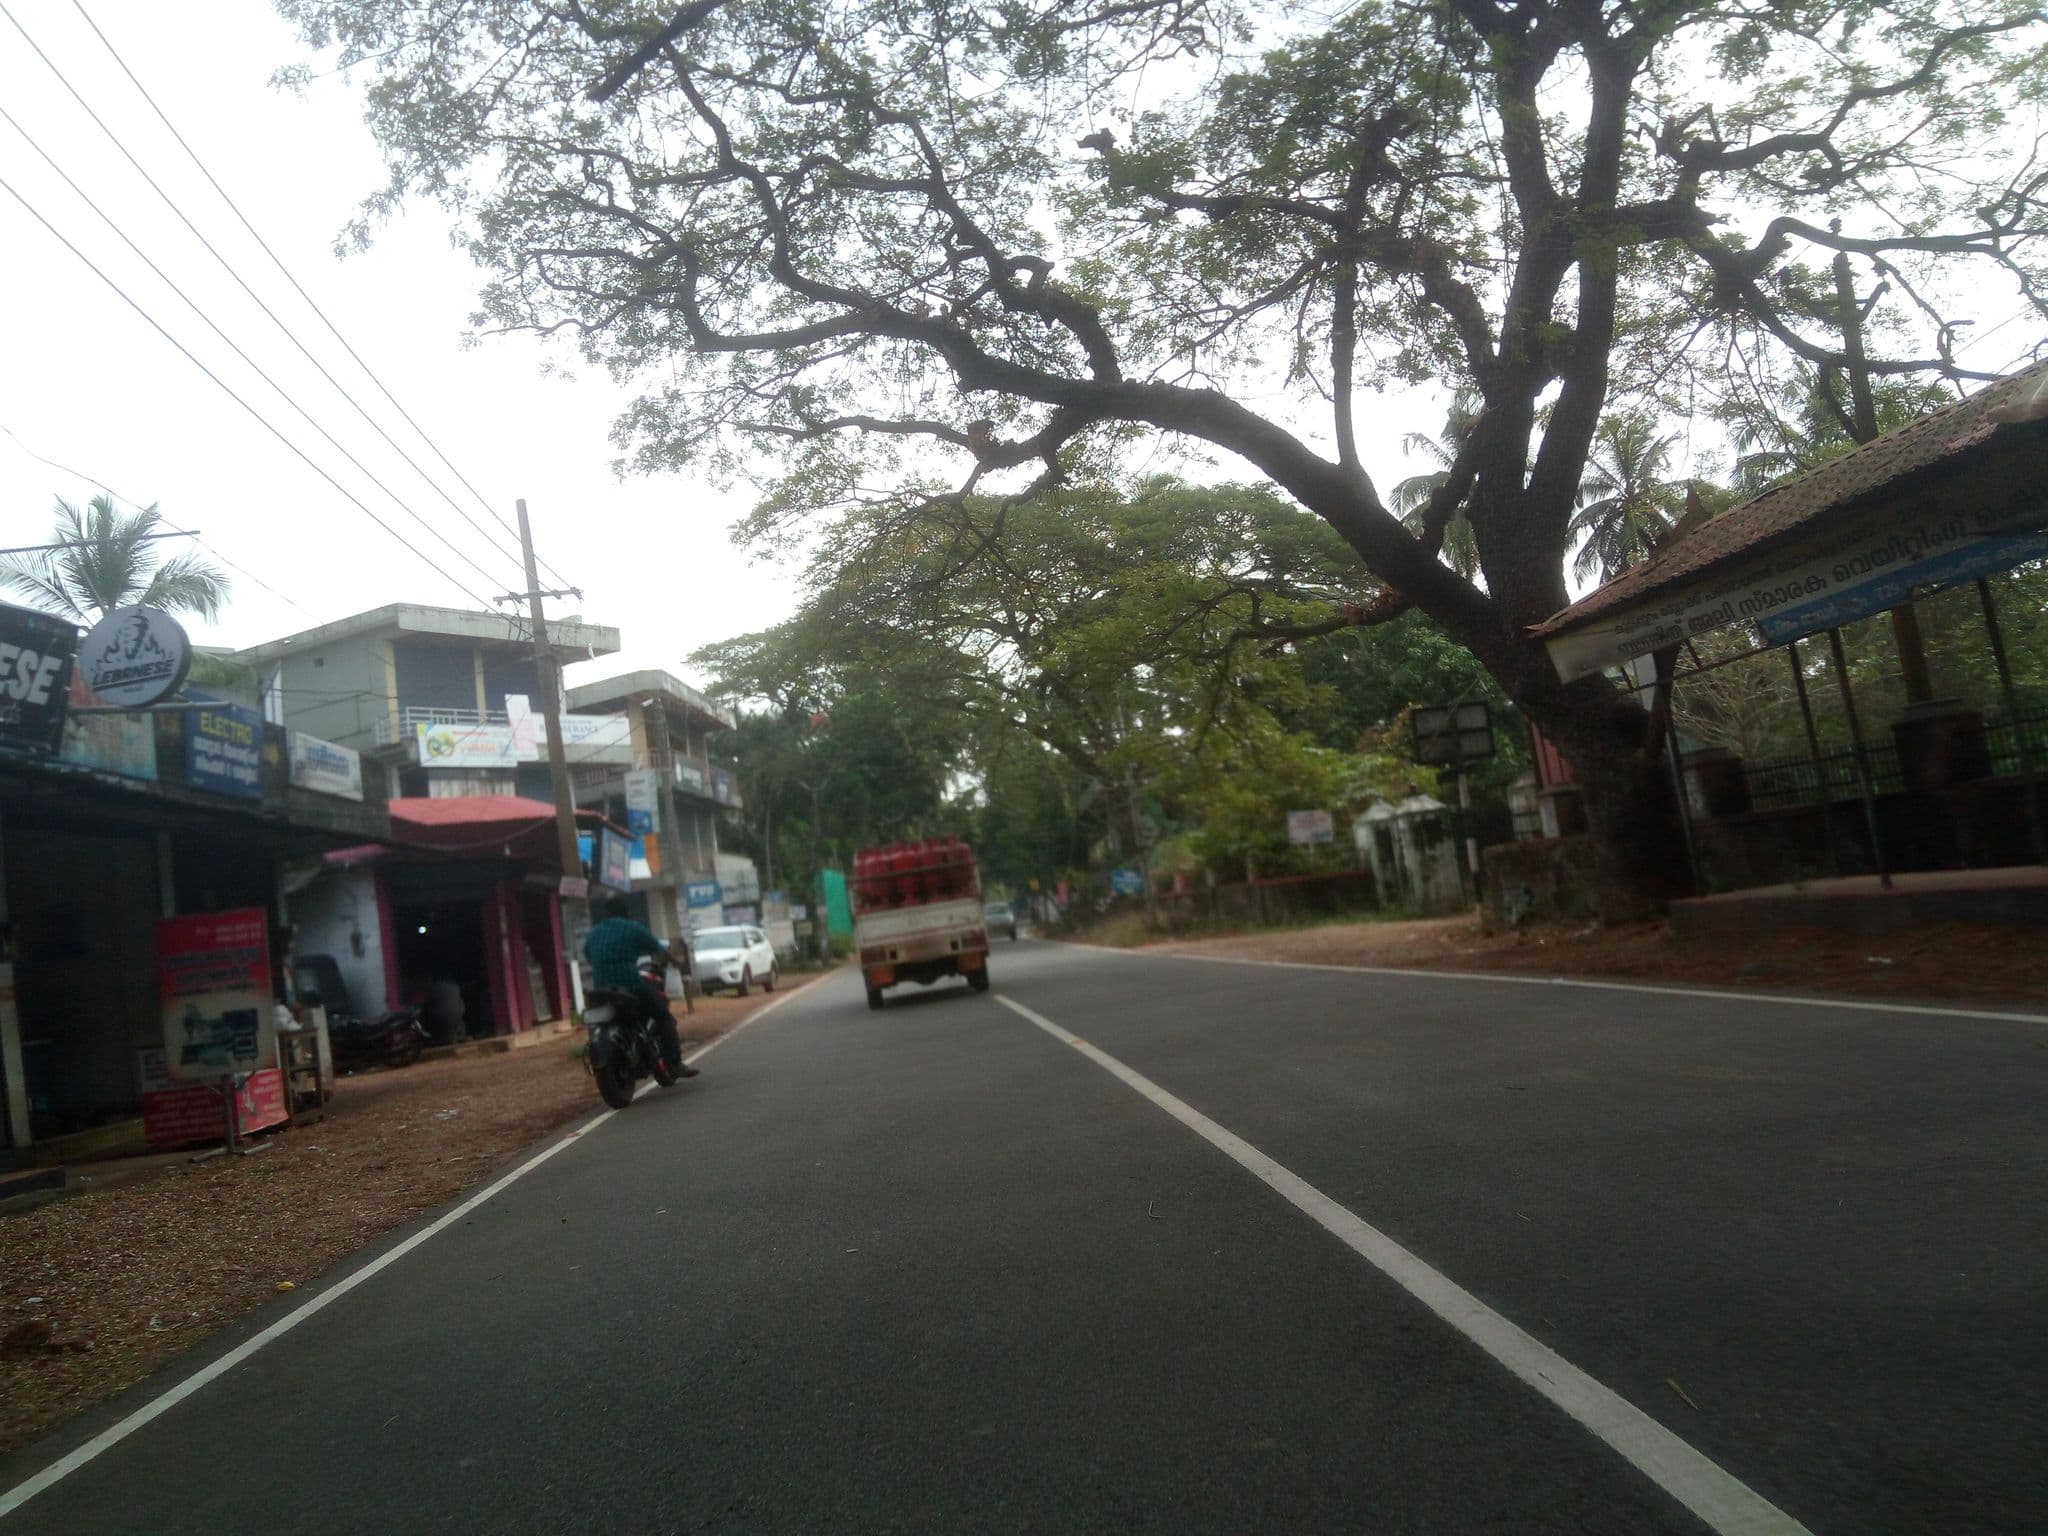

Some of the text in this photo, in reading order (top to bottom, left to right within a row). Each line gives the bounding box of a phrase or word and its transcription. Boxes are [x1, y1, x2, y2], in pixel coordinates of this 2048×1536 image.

[1738, 570, 1827, 617] സ്മാരക
[93, 659, 175, 686] LEBANESE
[200, 711, 253, 745] ELECTRO
